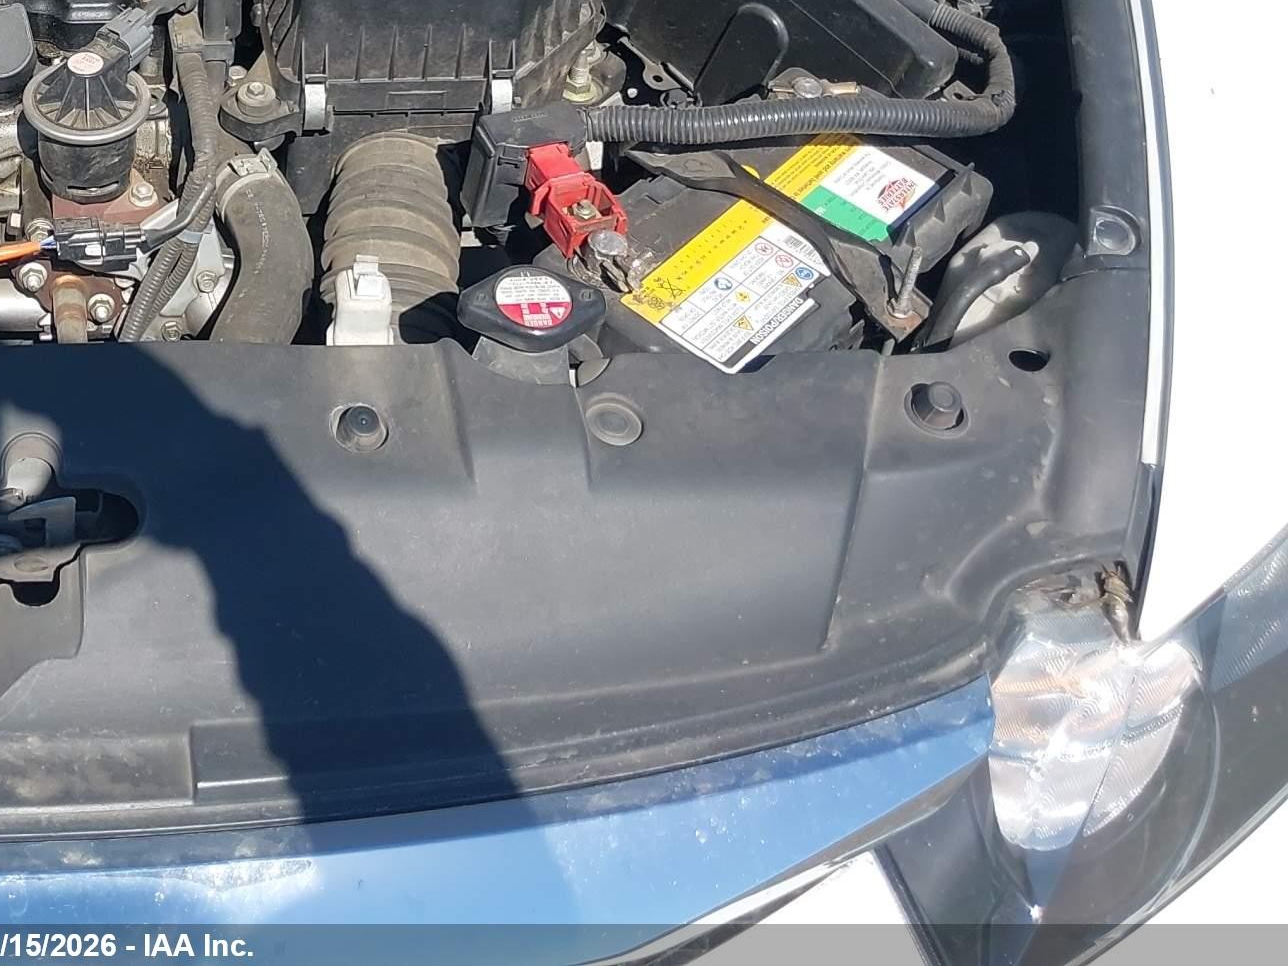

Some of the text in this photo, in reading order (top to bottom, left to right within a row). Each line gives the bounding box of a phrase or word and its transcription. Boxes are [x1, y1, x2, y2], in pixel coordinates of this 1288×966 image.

[876, 177, 909, 206] BATTERIES
[882, 179, 919, 212] INTERSTATE
[749, 297, 804, 345] DANGER/POISON
